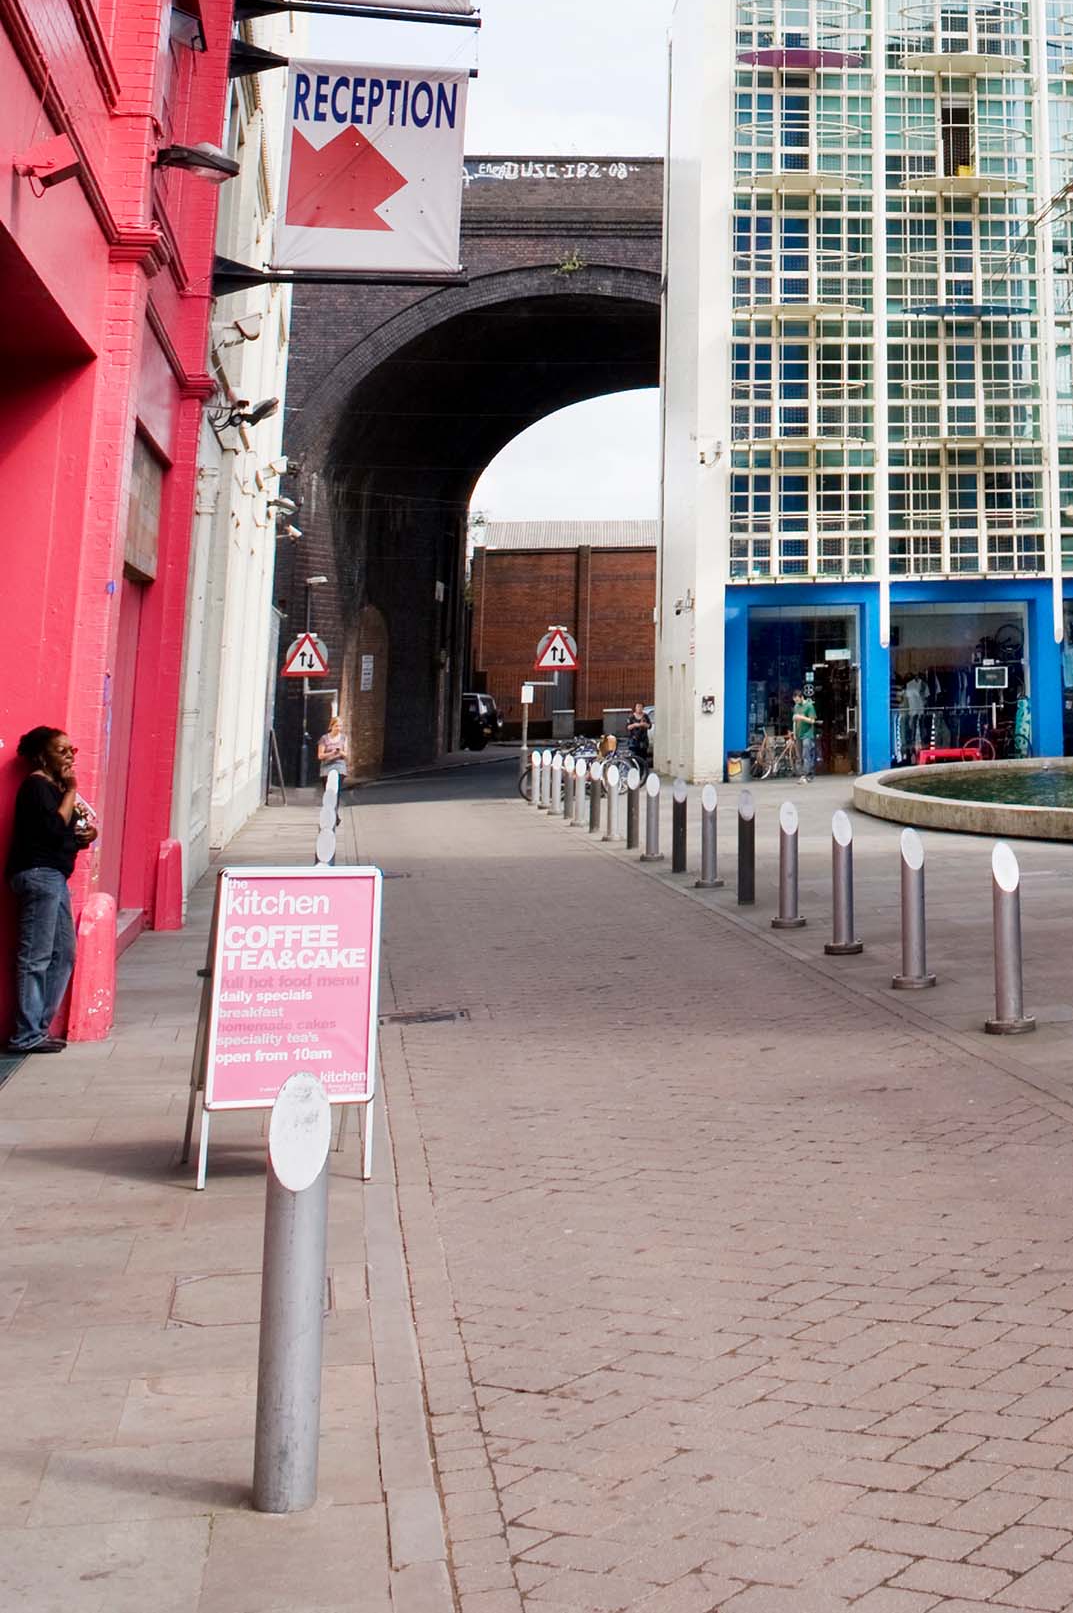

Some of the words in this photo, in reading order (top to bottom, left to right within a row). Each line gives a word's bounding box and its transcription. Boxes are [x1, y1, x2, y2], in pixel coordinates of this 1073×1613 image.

[293, 73, 458, 129] RECEPTION
[228, 878, 248, 889] the
[226, 889, 330, 916] kitchen
[224, 924, 339, 949] COFFEE
[223, 948, 367, 971] TEA&CAKE
[249, 975, 273, 988] hot
[278, 974, 312, 988] food
[317, 975, 360, 987] menu
[220, 991, 252, 1004] daily
[256, 989, 313, 1004] specials
[219, 1006, 285, 1019] breakfast
[218, 1020, 292, 1033] homemade
[296, 1019, 337, 1031] cakes
[215, 1051, 251, 1066] open
[255, 1049, 288, 1062] from
[293, 1047, 332, 1061] 10am
[320, 1070, 366, 1083] kitchen
